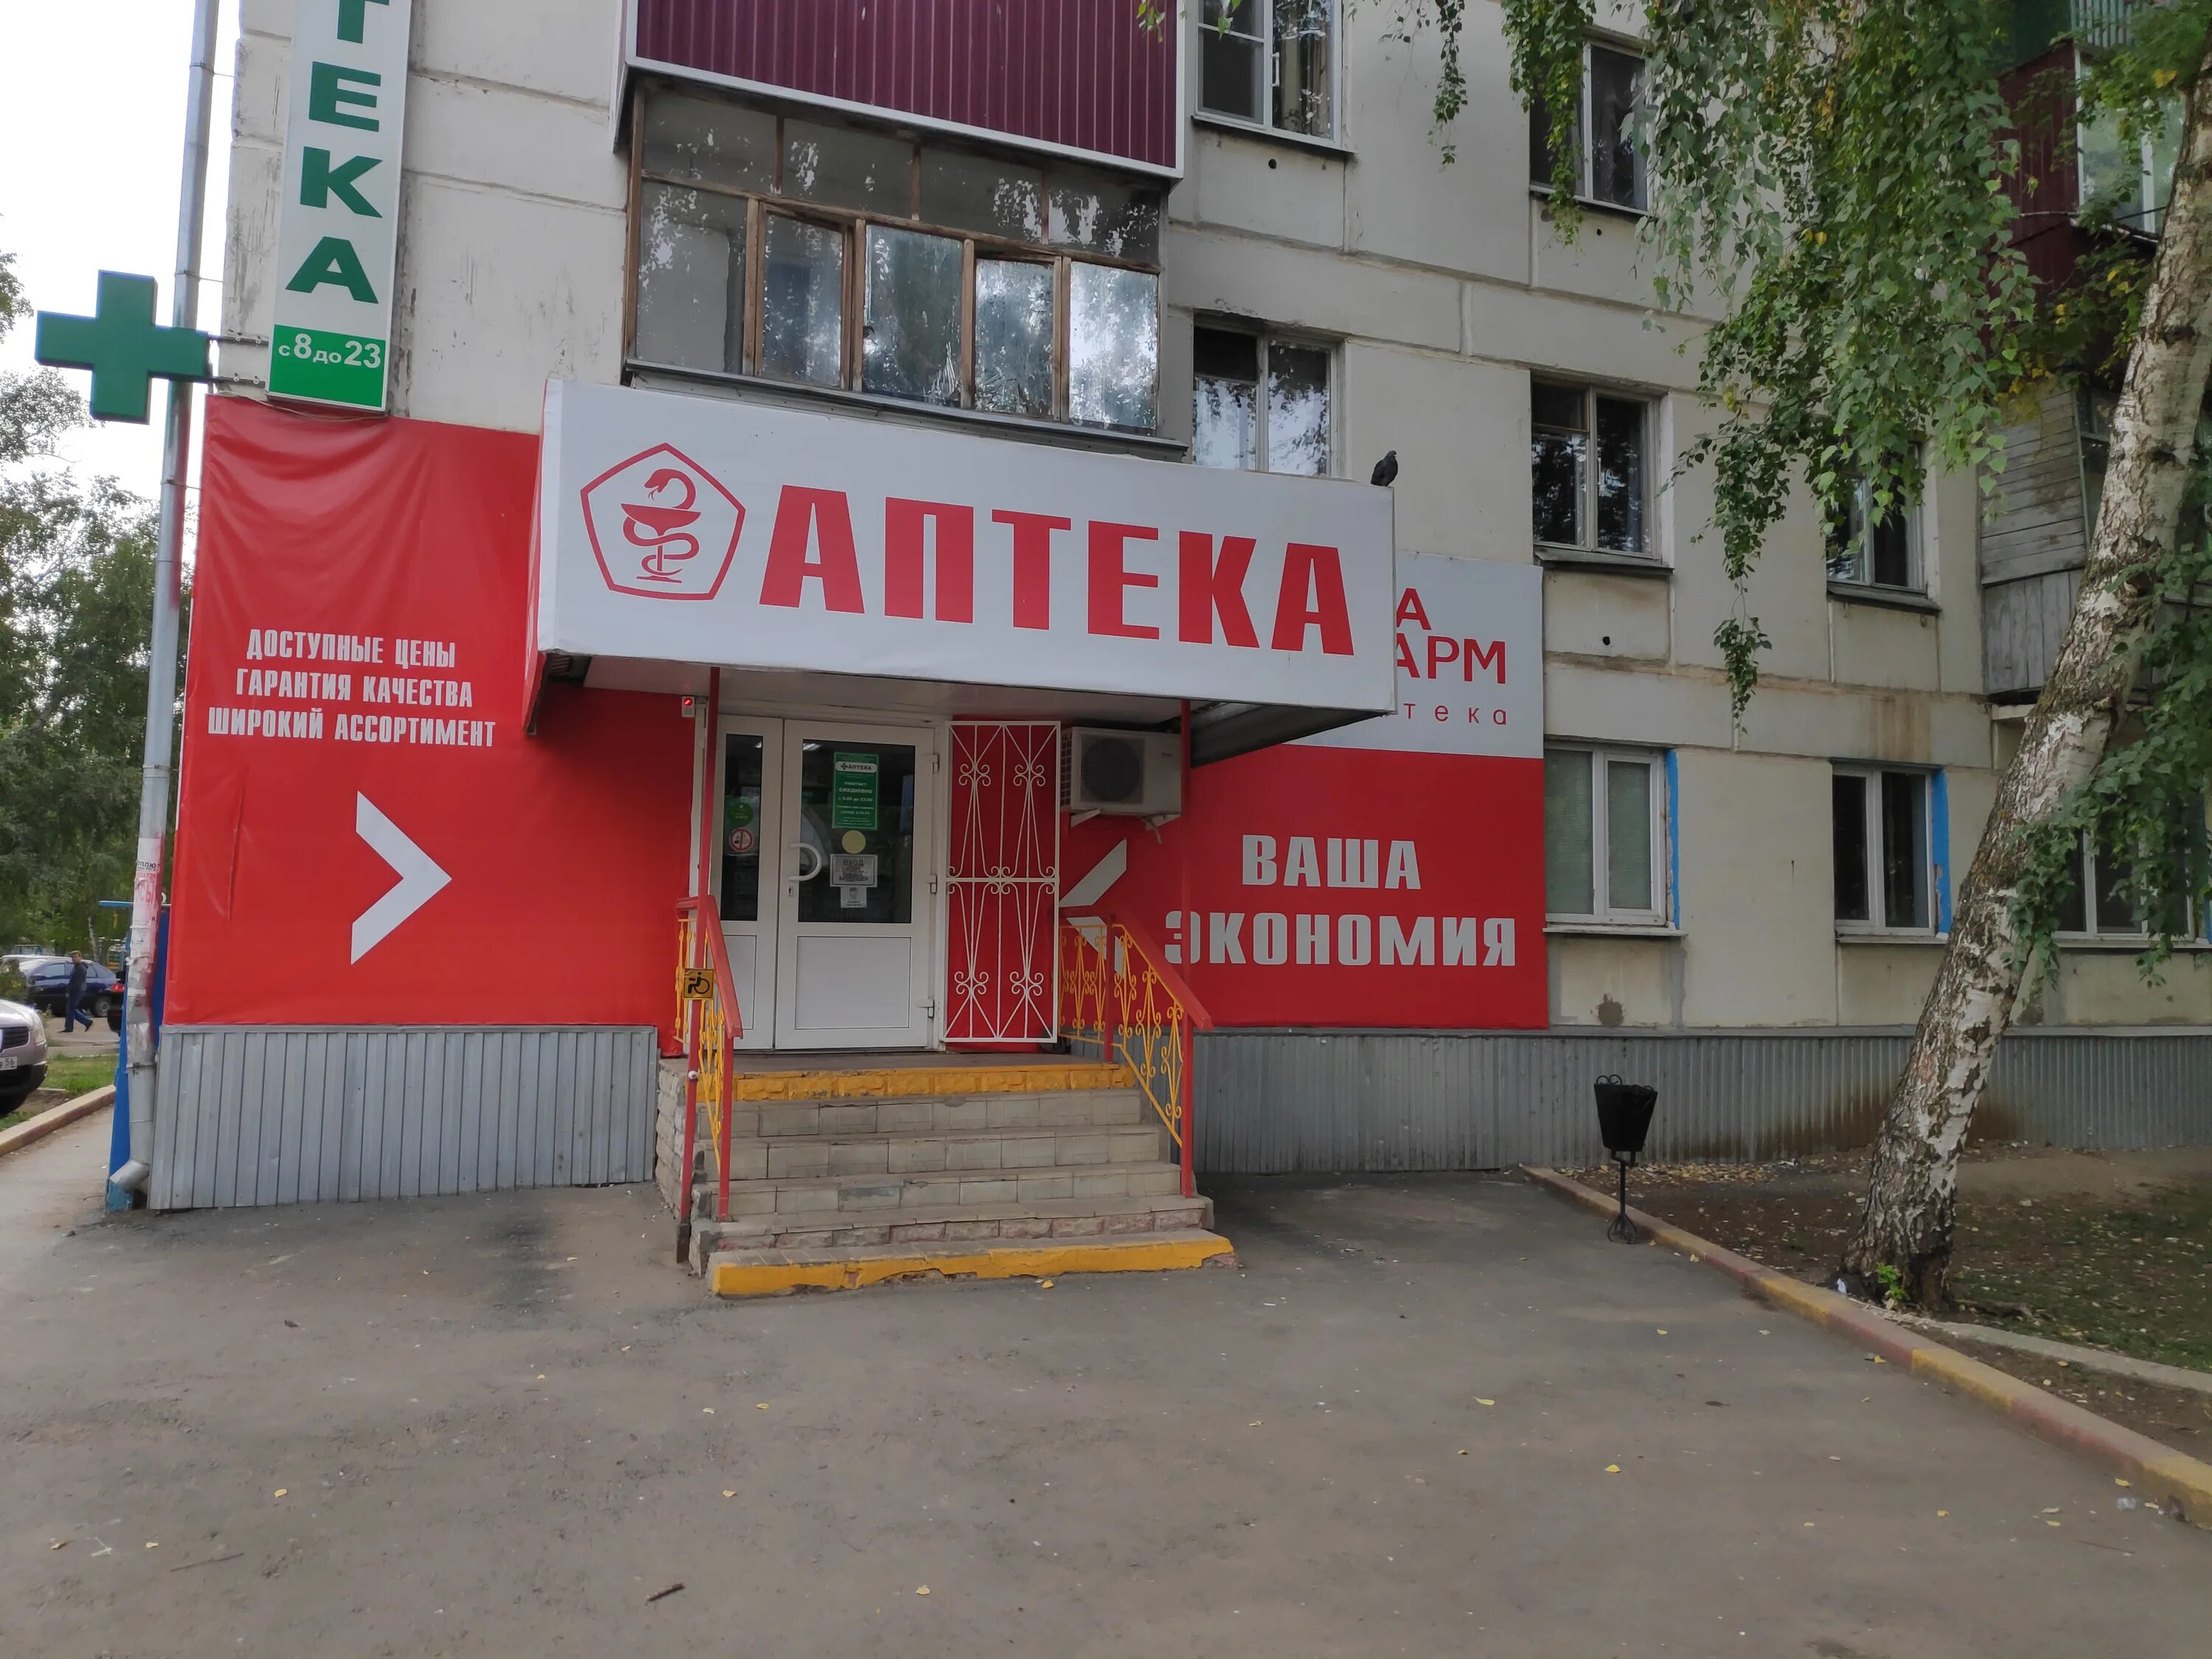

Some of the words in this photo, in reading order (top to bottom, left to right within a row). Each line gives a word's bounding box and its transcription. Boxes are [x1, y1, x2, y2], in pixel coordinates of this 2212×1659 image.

[344, 340, 380, 369] 23
[759, 484, 1354, 656] АПТЕКА
[247, 629, 383, 664] ДОСТУПНЫЕ
[394, 639, 456, 669] ЦЕНЫ
[236, 668, 351, 700] ГАРАНТИЯ
[363, 675, 473, 707] КАЧЕСТВА
[208, 707, 323, 739] ШИРОКИЙ
[334, 714, 495, 747] АССОРТИМЕНТ
[1242, 835, 1421, 890] ВАША
[1165, 910, 1515, 967] ЭКОНОМИЯ
